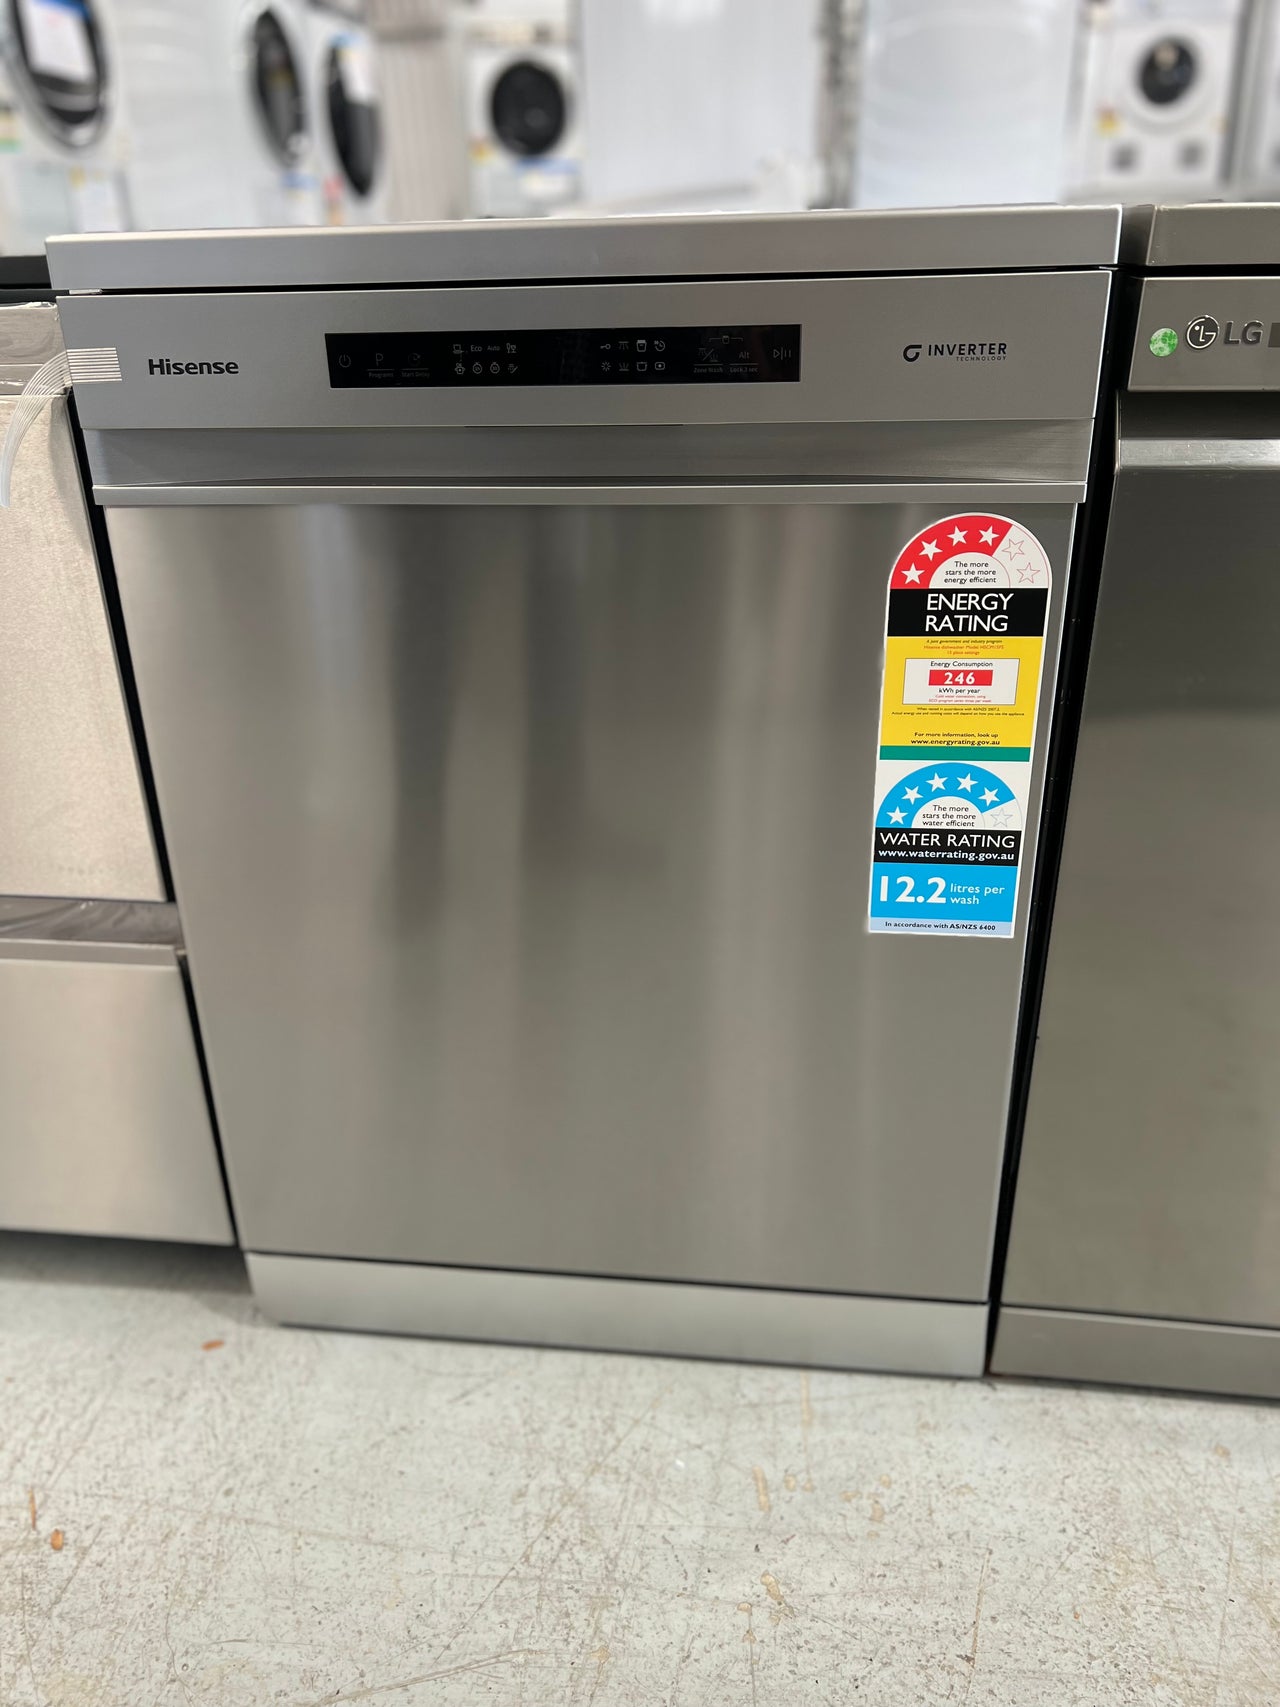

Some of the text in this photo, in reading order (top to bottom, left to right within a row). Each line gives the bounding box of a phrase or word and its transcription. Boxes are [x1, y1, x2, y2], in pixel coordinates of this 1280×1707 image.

[1224, 320, 1264, 345] LG
[738, 351, 750, 359] Alt
[928, 342, 1007, 356] INVERTER
[376, 352, 384, 366] P
[148, 358, 239, 375] Hisense
[926, 593, 1014, 611] ENERGY
[925, 614, 1009, 632] RATING
[944, 672, 975, 685] 246
[880, 832, 1016, 848] WATER RATING
[878, 850, 1014, 861] www.waterrating.gov.au
[880, 875, 946, 904] 12.2
[950, 883, 1005, 896] litres per
[950, 895, 980, 904] wash
